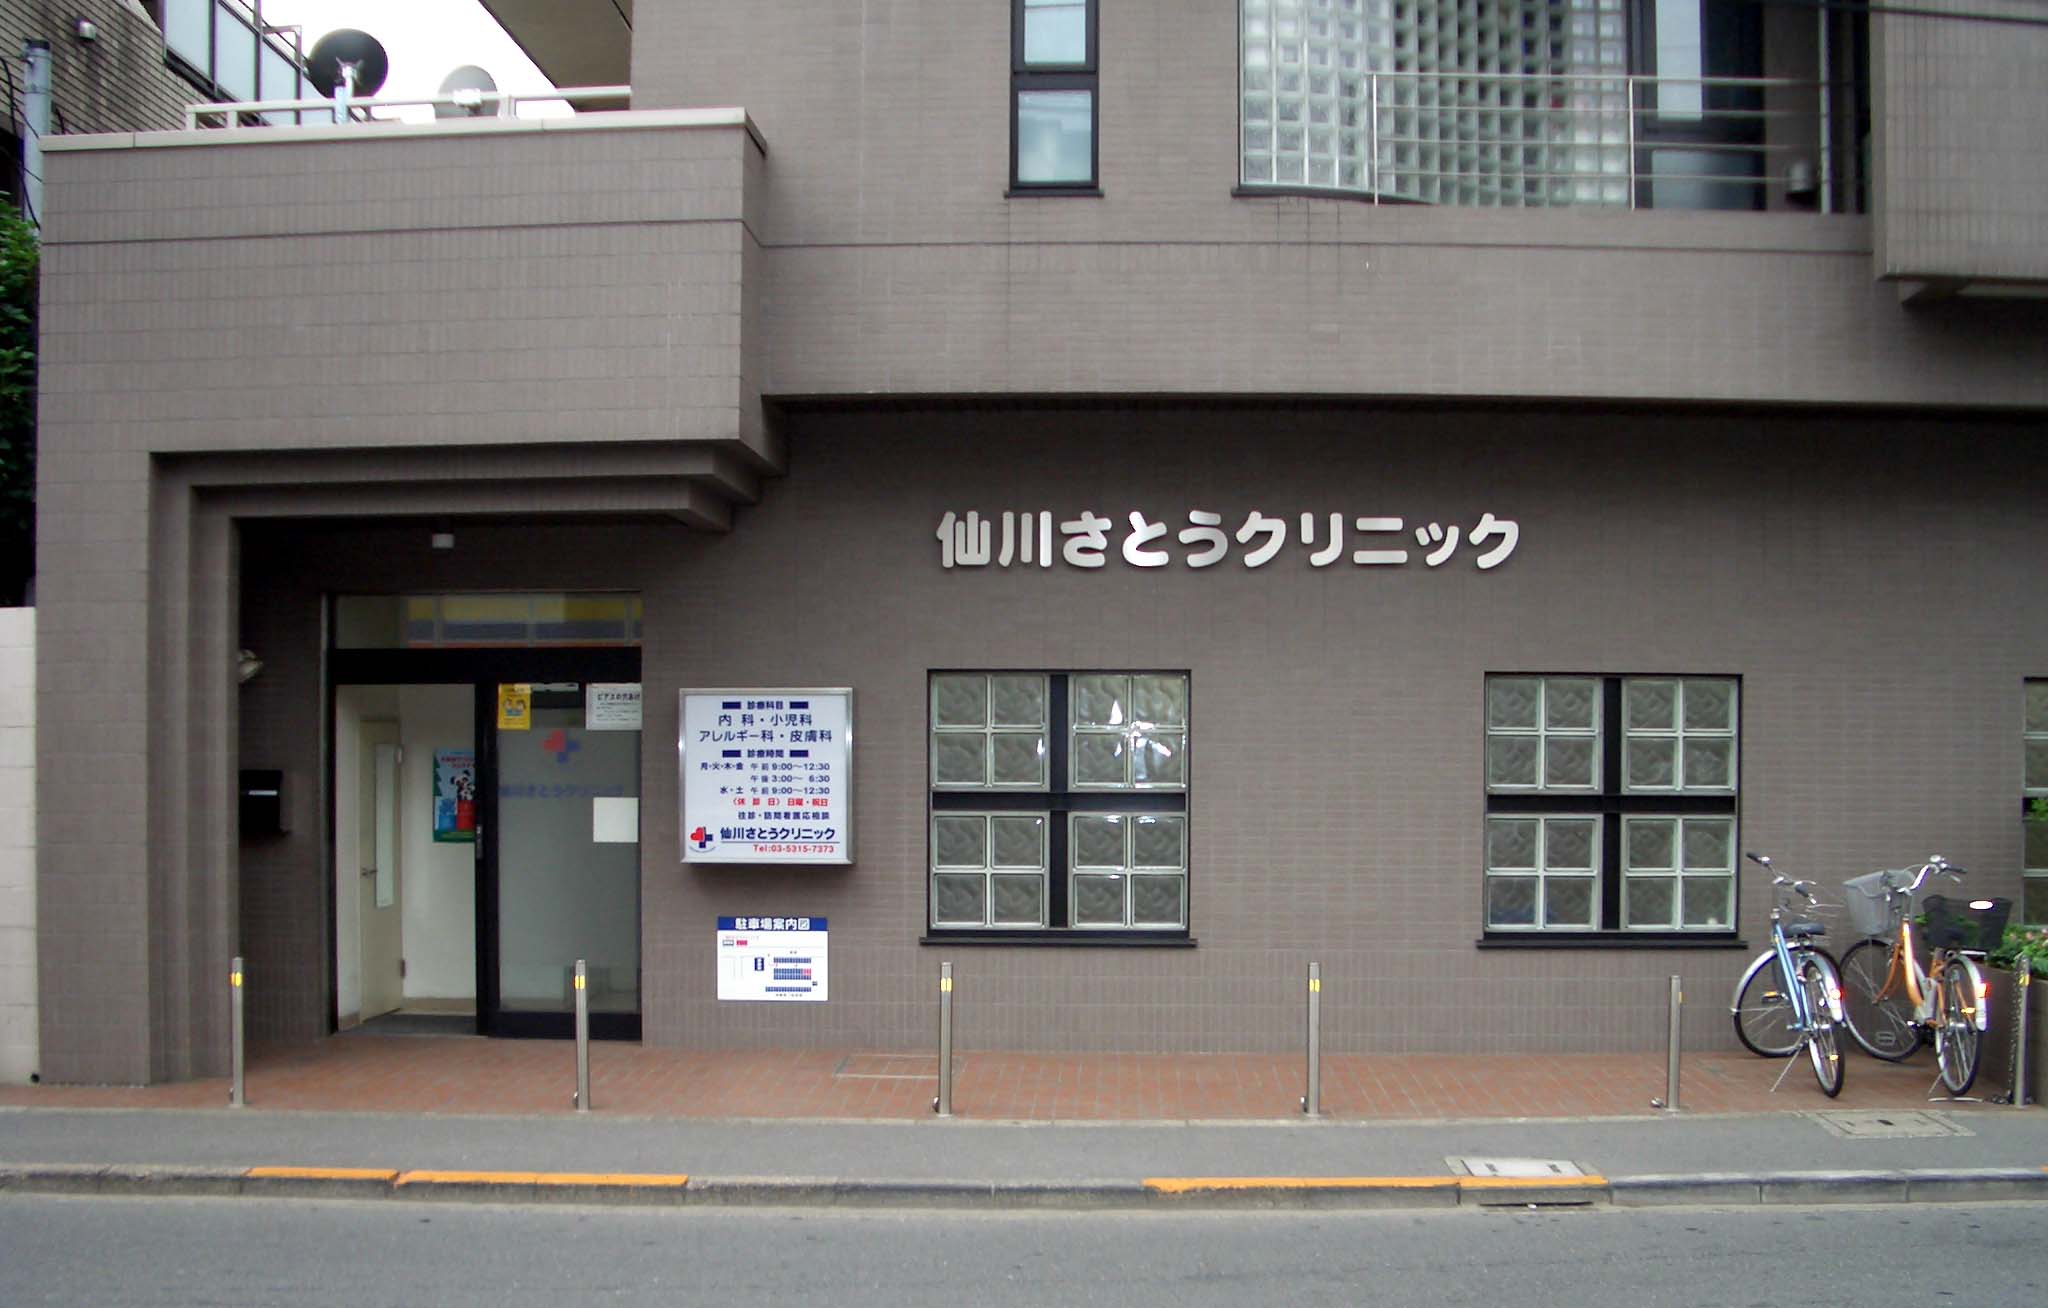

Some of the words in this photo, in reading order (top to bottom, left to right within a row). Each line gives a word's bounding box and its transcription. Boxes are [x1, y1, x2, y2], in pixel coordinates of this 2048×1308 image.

[936, 510, 1520, 569] 仙川さとうクリニック
[747, 701, 784, 710] 診療科目
[699, 730, 832, 742] アレルギー科・皮膚科
[747, 749, 784, 758] 診療時間
[720, 827, 835, 840] 仙川さとうクリニック
[735, 917, 810, 930] 駐車場案内図
